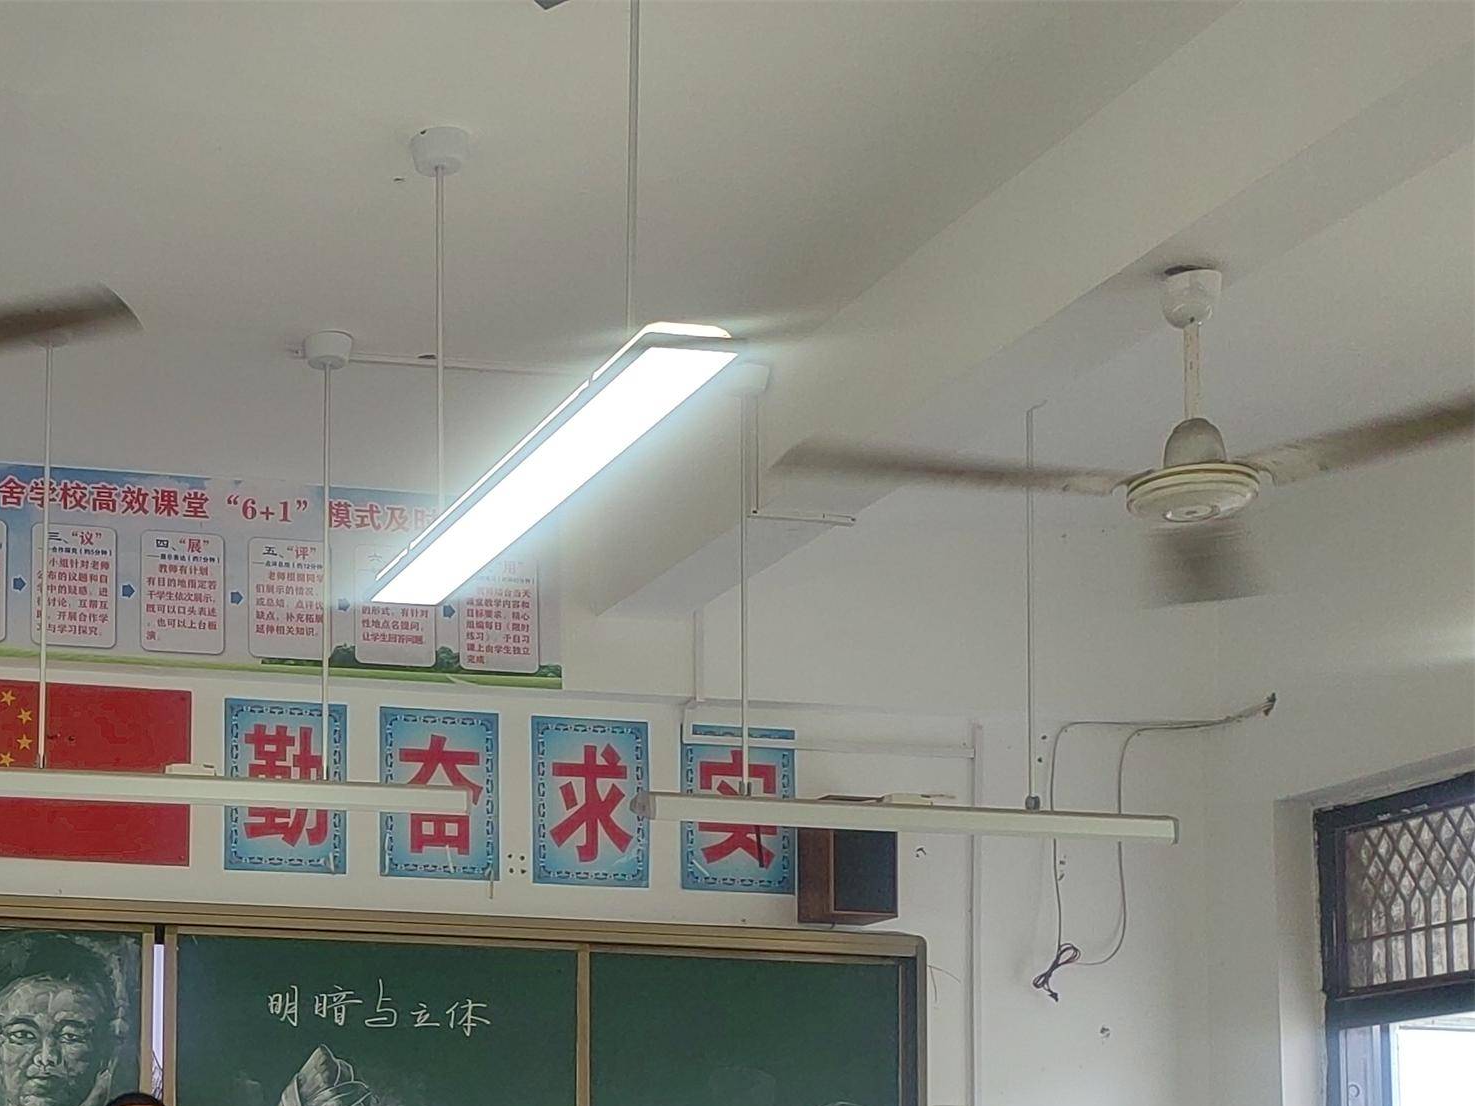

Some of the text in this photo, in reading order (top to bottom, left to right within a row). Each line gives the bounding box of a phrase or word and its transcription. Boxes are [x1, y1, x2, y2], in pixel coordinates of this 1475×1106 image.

[49, 558, 111, 571] 小组针对老师
[267, 978, 492, 1037] 明暗与立体
